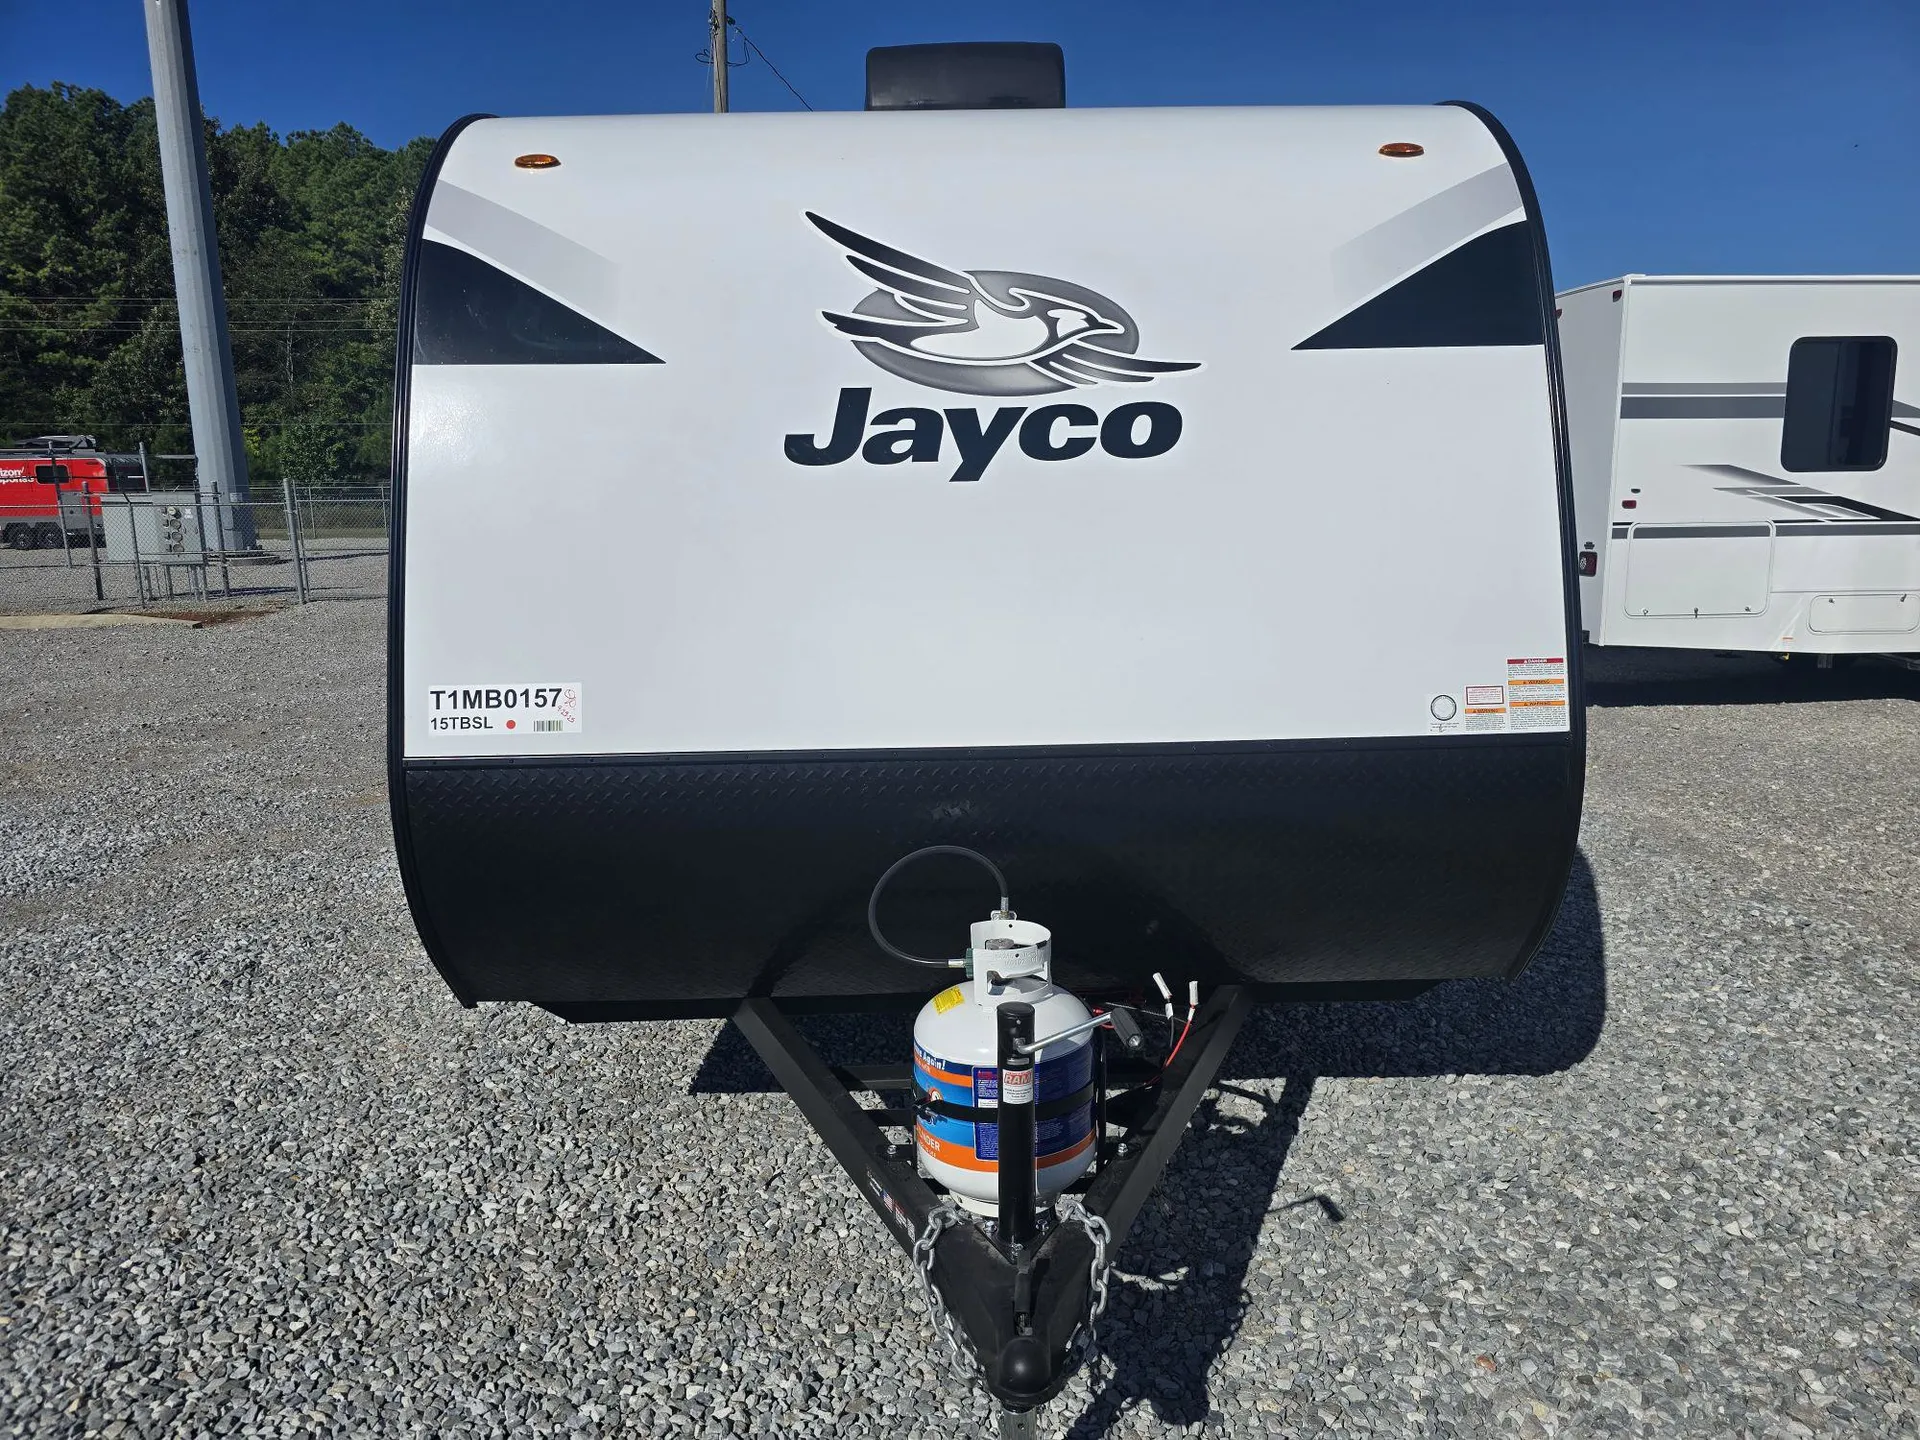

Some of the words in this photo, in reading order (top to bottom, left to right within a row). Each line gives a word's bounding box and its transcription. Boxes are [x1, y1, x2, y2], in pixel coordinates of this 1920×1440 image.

[783, 387, 1183, 482] Jayco
[430, 688, 562, 710] T1MB0157
[430, 716, 493, 731] 15TBSL
